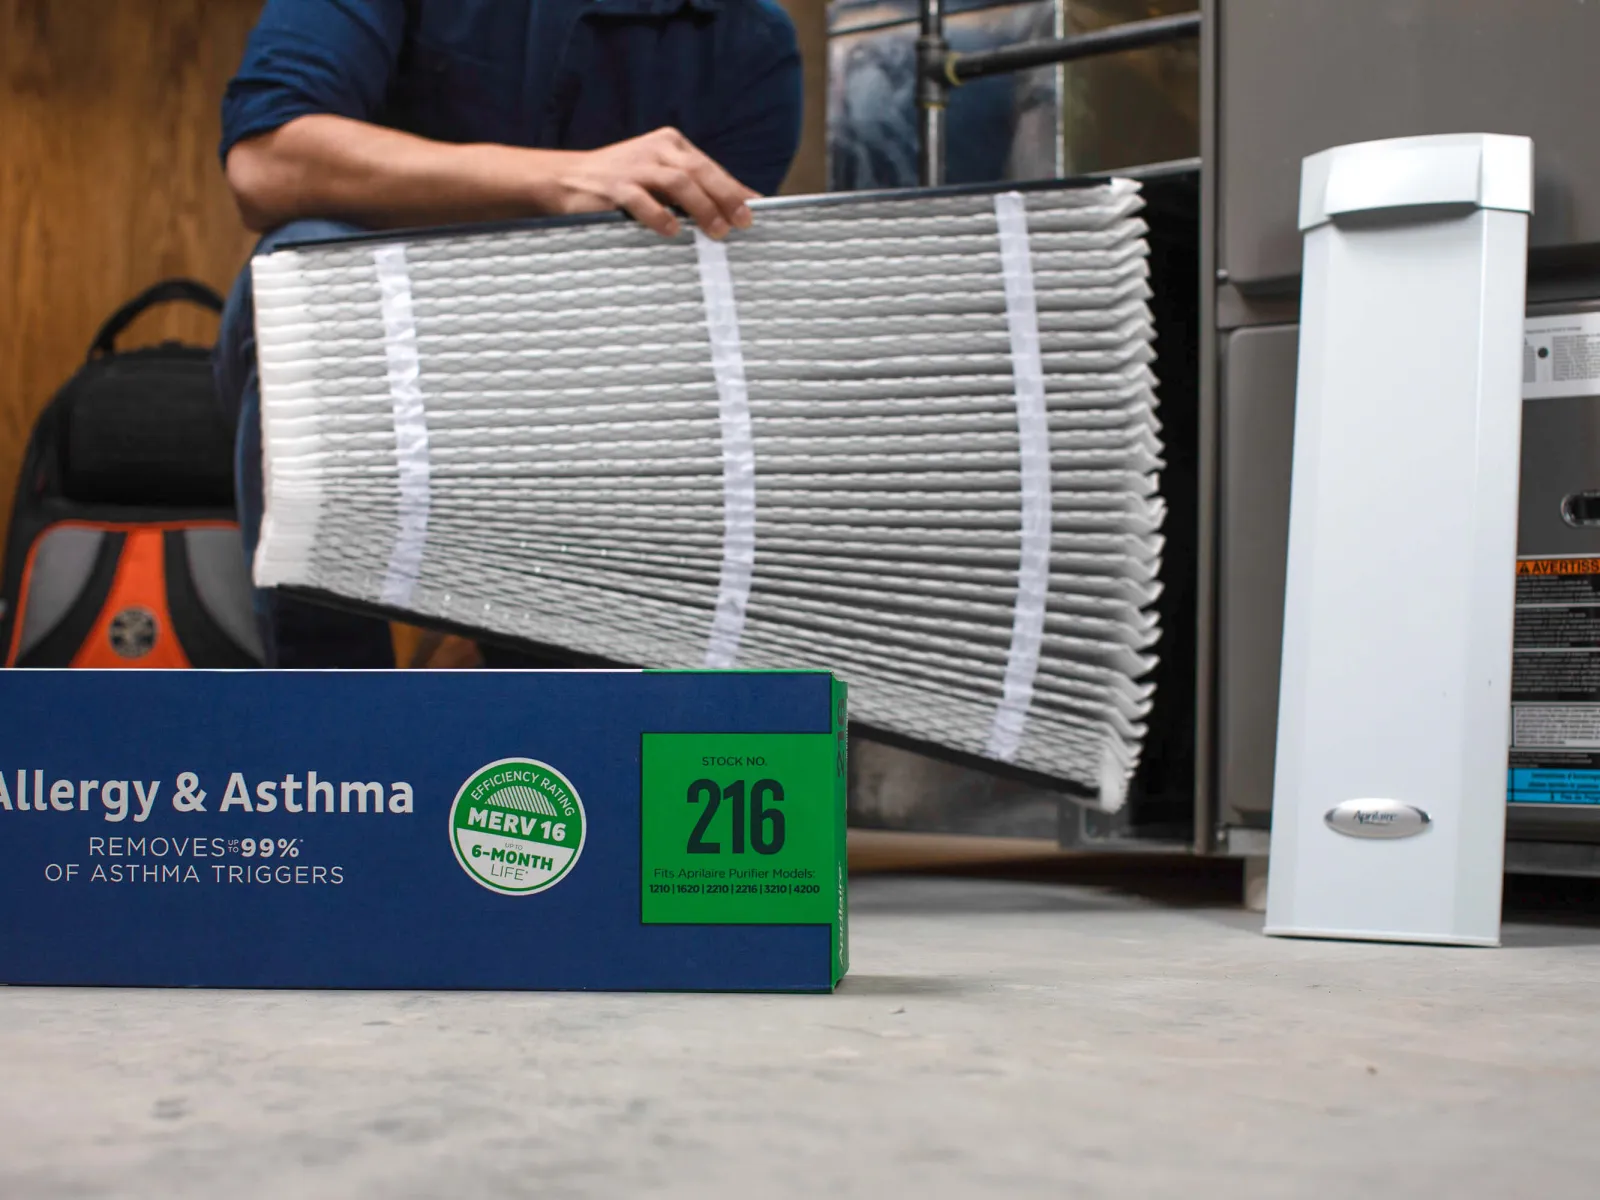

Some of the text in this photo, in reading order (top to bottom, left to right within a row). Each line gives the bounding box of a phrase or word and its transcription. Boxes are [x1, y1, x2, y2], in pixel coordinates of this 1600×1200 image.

[702, 756, 768, 767] STOCK NO.
[172, 771, 207, 813] &
[219, 771, 415, 814] Asthma
[470, 770, 576, 817] EFFICIENCY RATING
[467, 807, 567, 842] MERV 16
[686, 778, 786, 855] 216
[89, 837, 226, 857] REMOVES
[471, 844, 554, 871] 6-MONTH
[45, 864, 345, 884] OF ASTHMA TRIGGERS
[654, 868, 816, 880] Fits Aprilaire Purifier Models:
[649, 884, 820, 894] 1210 1620 2210 2216 3210 4200
